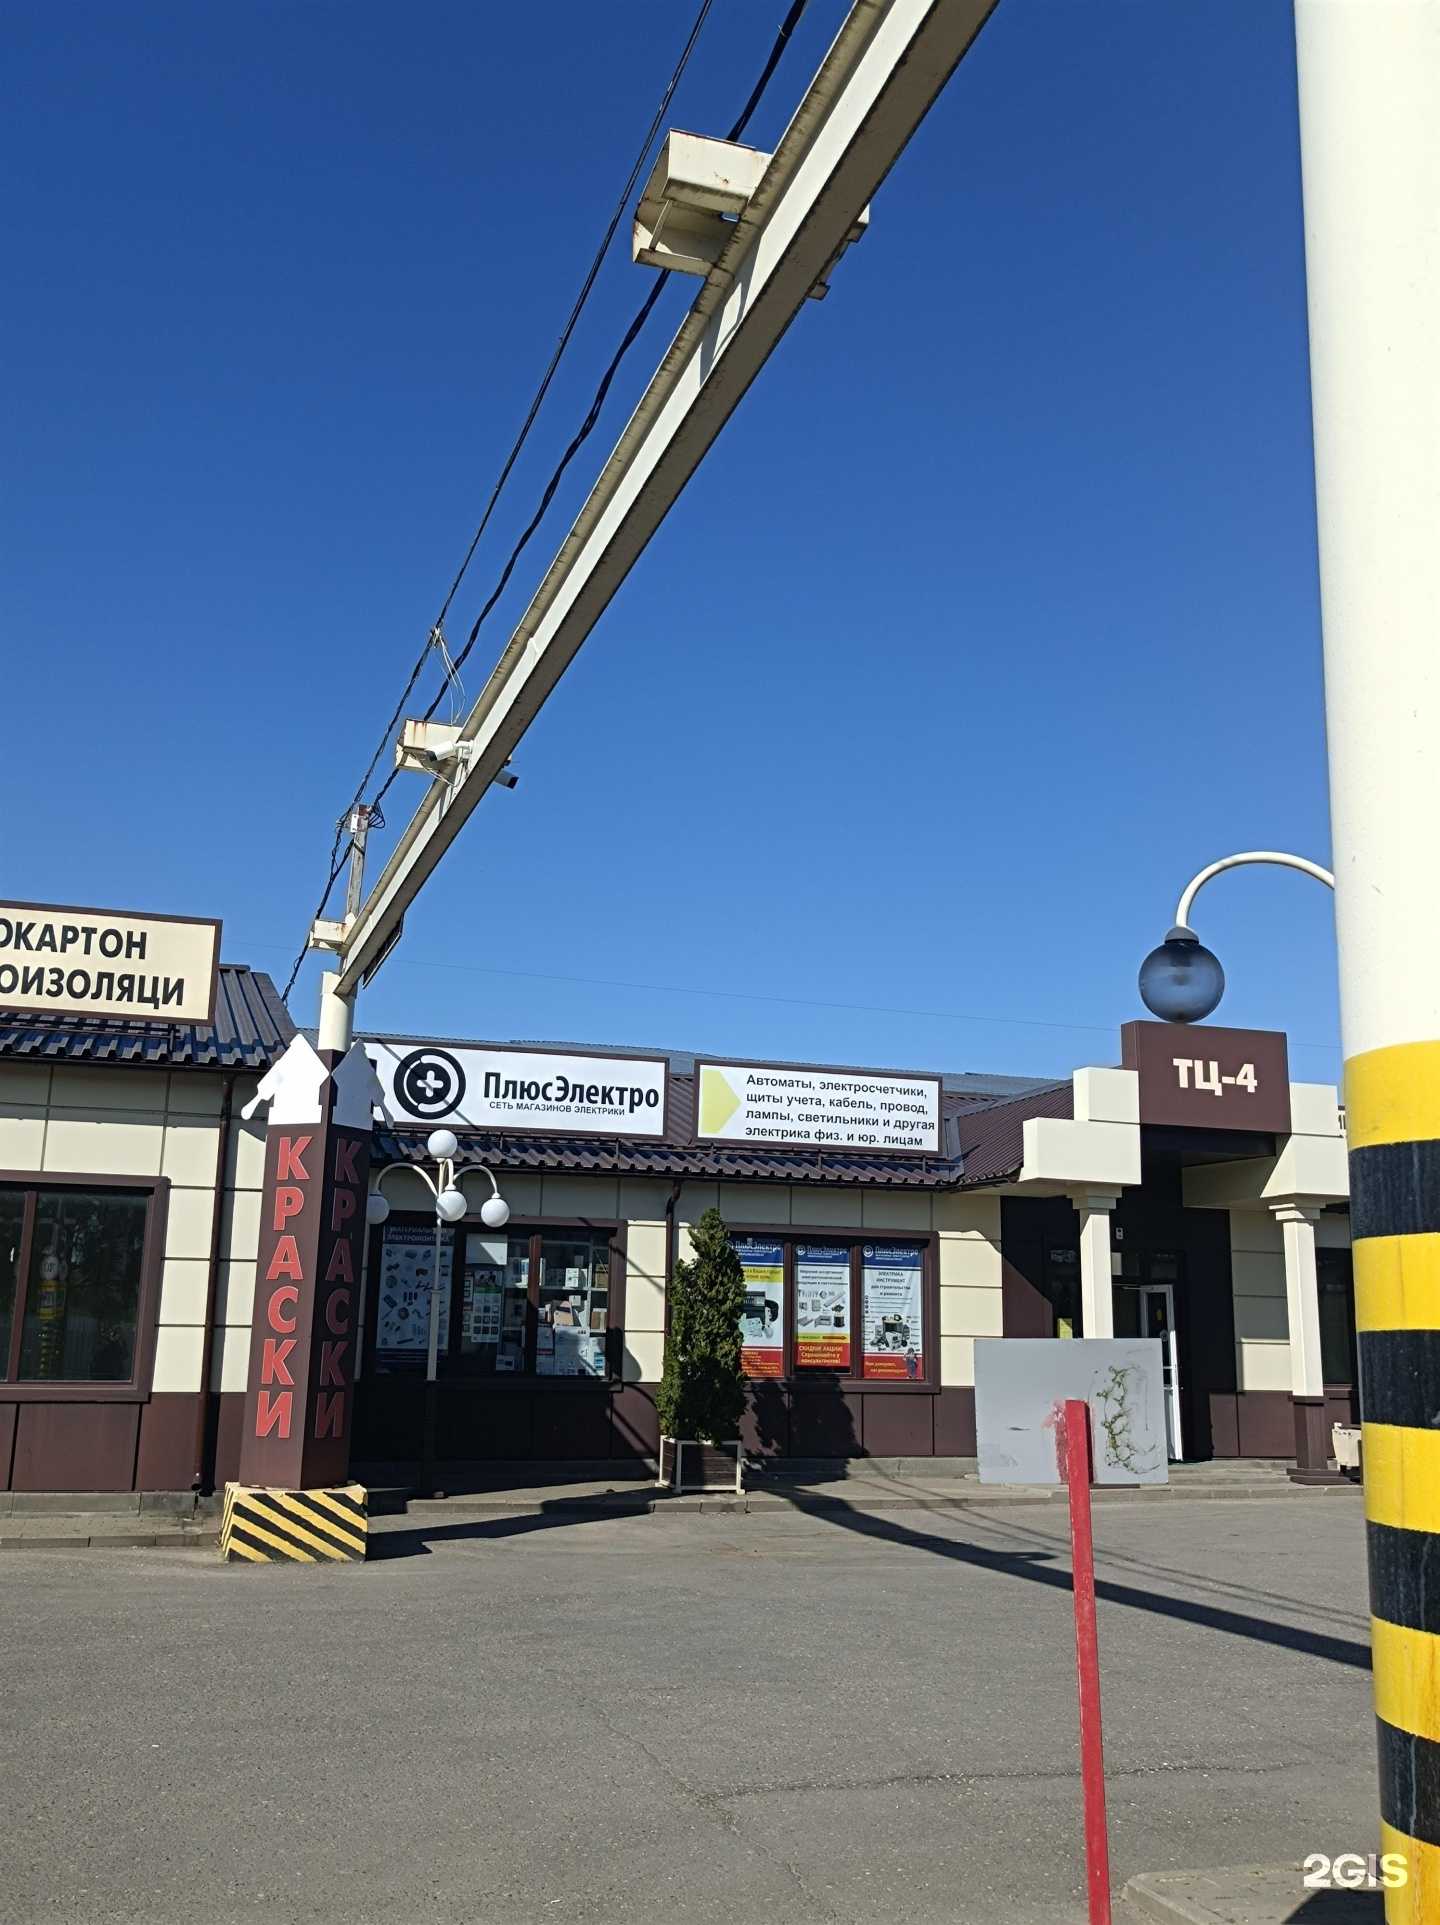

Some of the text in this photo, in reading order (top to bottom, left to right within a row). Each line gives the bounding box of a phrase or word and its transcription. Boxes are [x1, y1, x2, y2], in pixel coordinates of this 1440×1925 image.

[0, 963, 185, 1009] ОИЗОЛЯЦИ
[746, 1074, 927, 1099] Автоматы, электросчетчики,
[1173, 1058, 1258, 1097] ТЦ-4
[483, 1071, 660, 1114] ПлюсЭлектро
[746, 1093, 928, 1116] щиты учета, кабель, провод,
[489, 1101, 625, 1116] СЕТЬ МАГАЗИНОВ ЭЛЕКТРИКИ
[745, 1110, 935, 1132] лампы, светильники и другая
[745, 1127, 923, 1147] электрика физ. и юр. лицам
[255, 1136, 314, 1438] КРАСКИ
